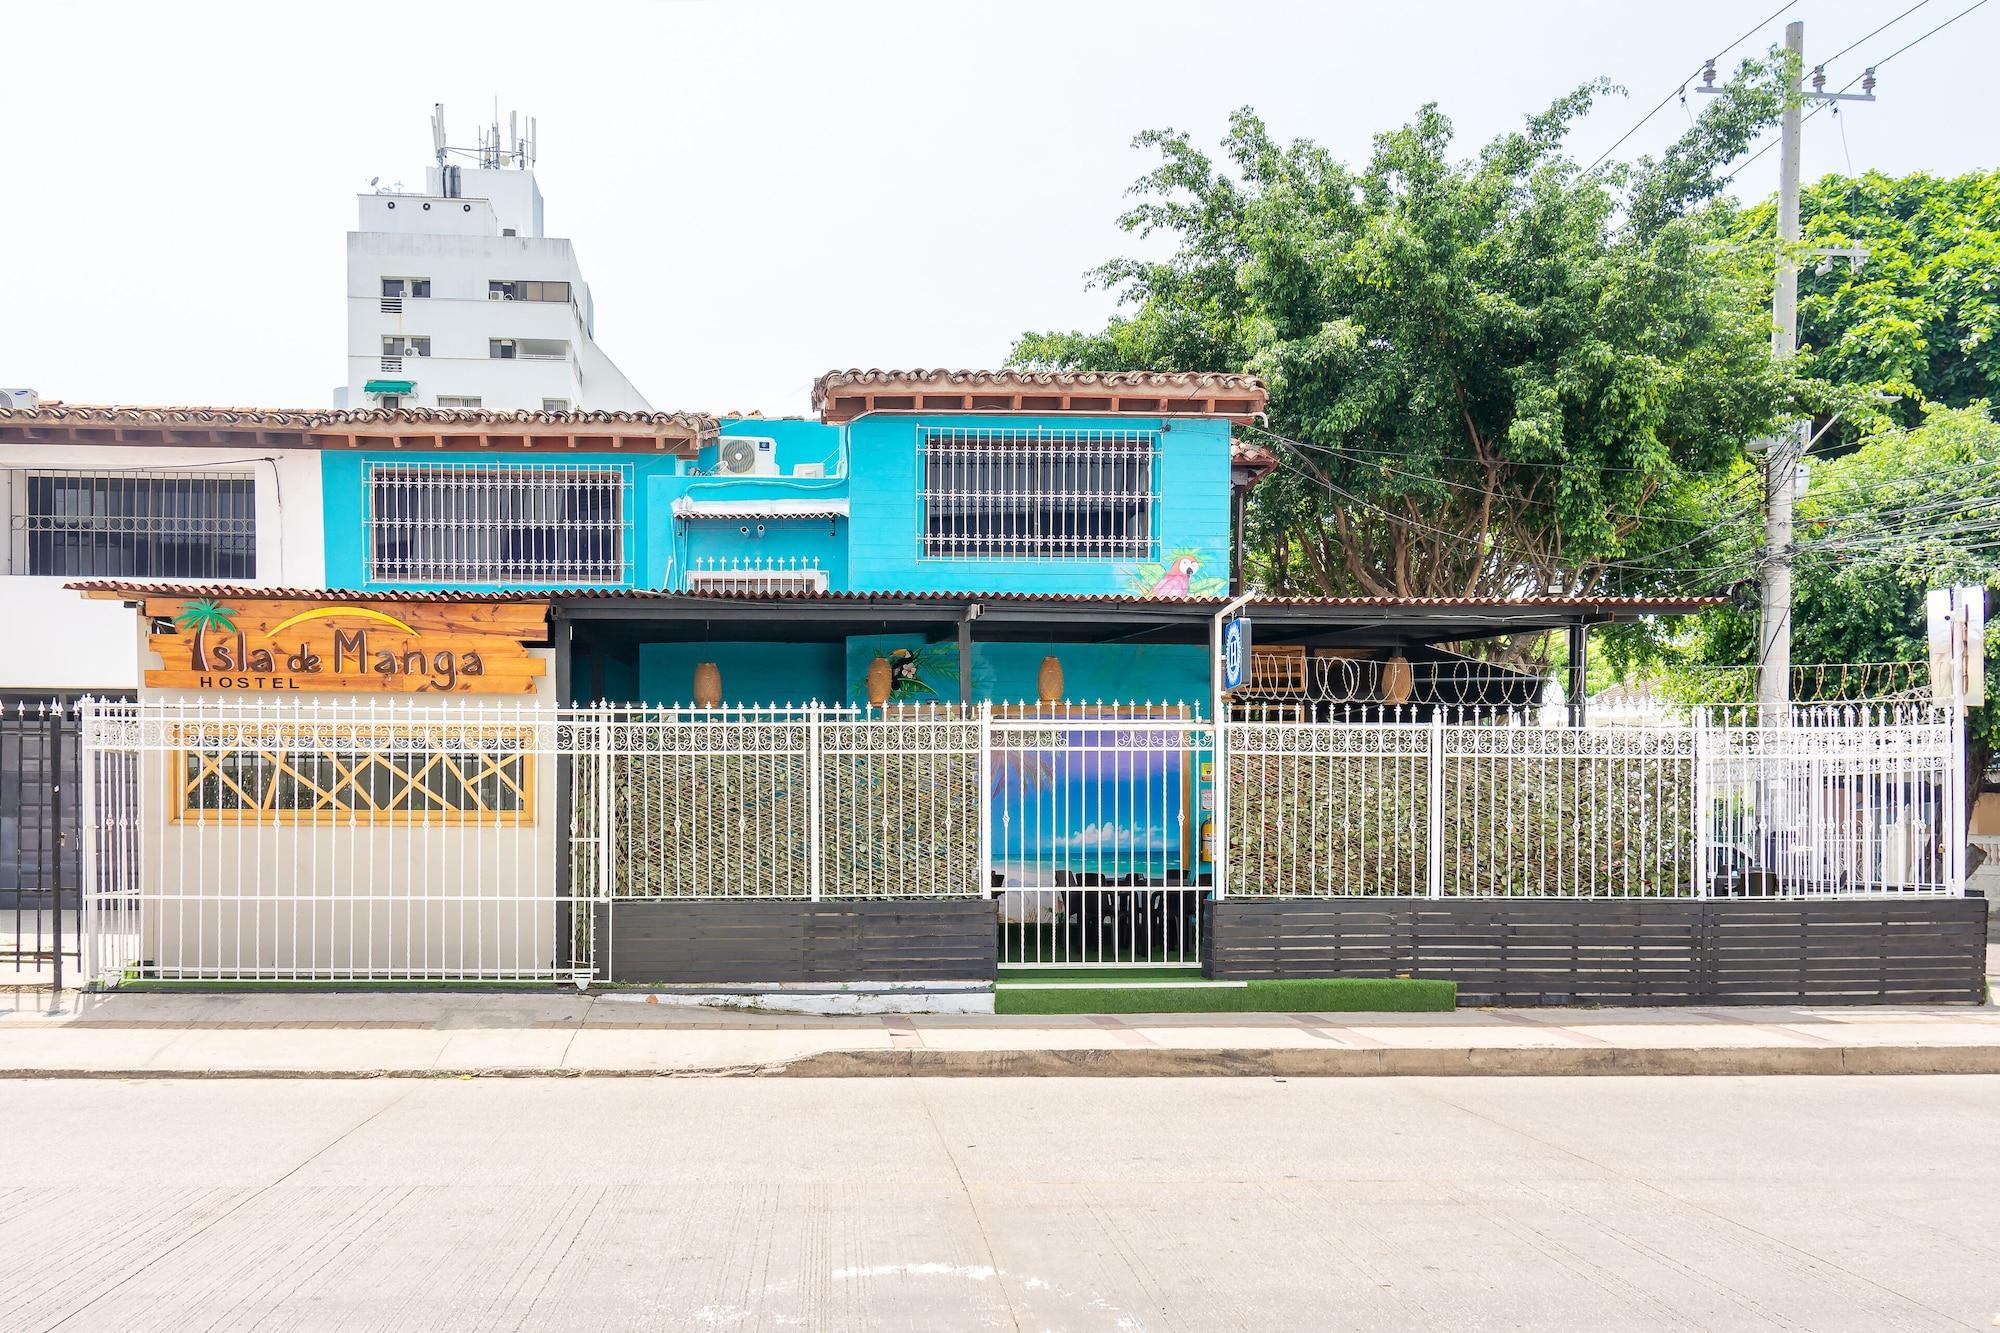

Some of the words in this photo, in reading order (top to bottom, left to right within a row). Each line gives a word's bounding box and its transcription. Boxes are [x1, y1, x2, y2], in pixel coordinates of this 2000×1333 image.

[192, 630, 275, 673] Isla
[287, 643, 323, 673] de
[334, 628, 485, 691] Manga
[200, 676, 300, 689] HOSTEL
